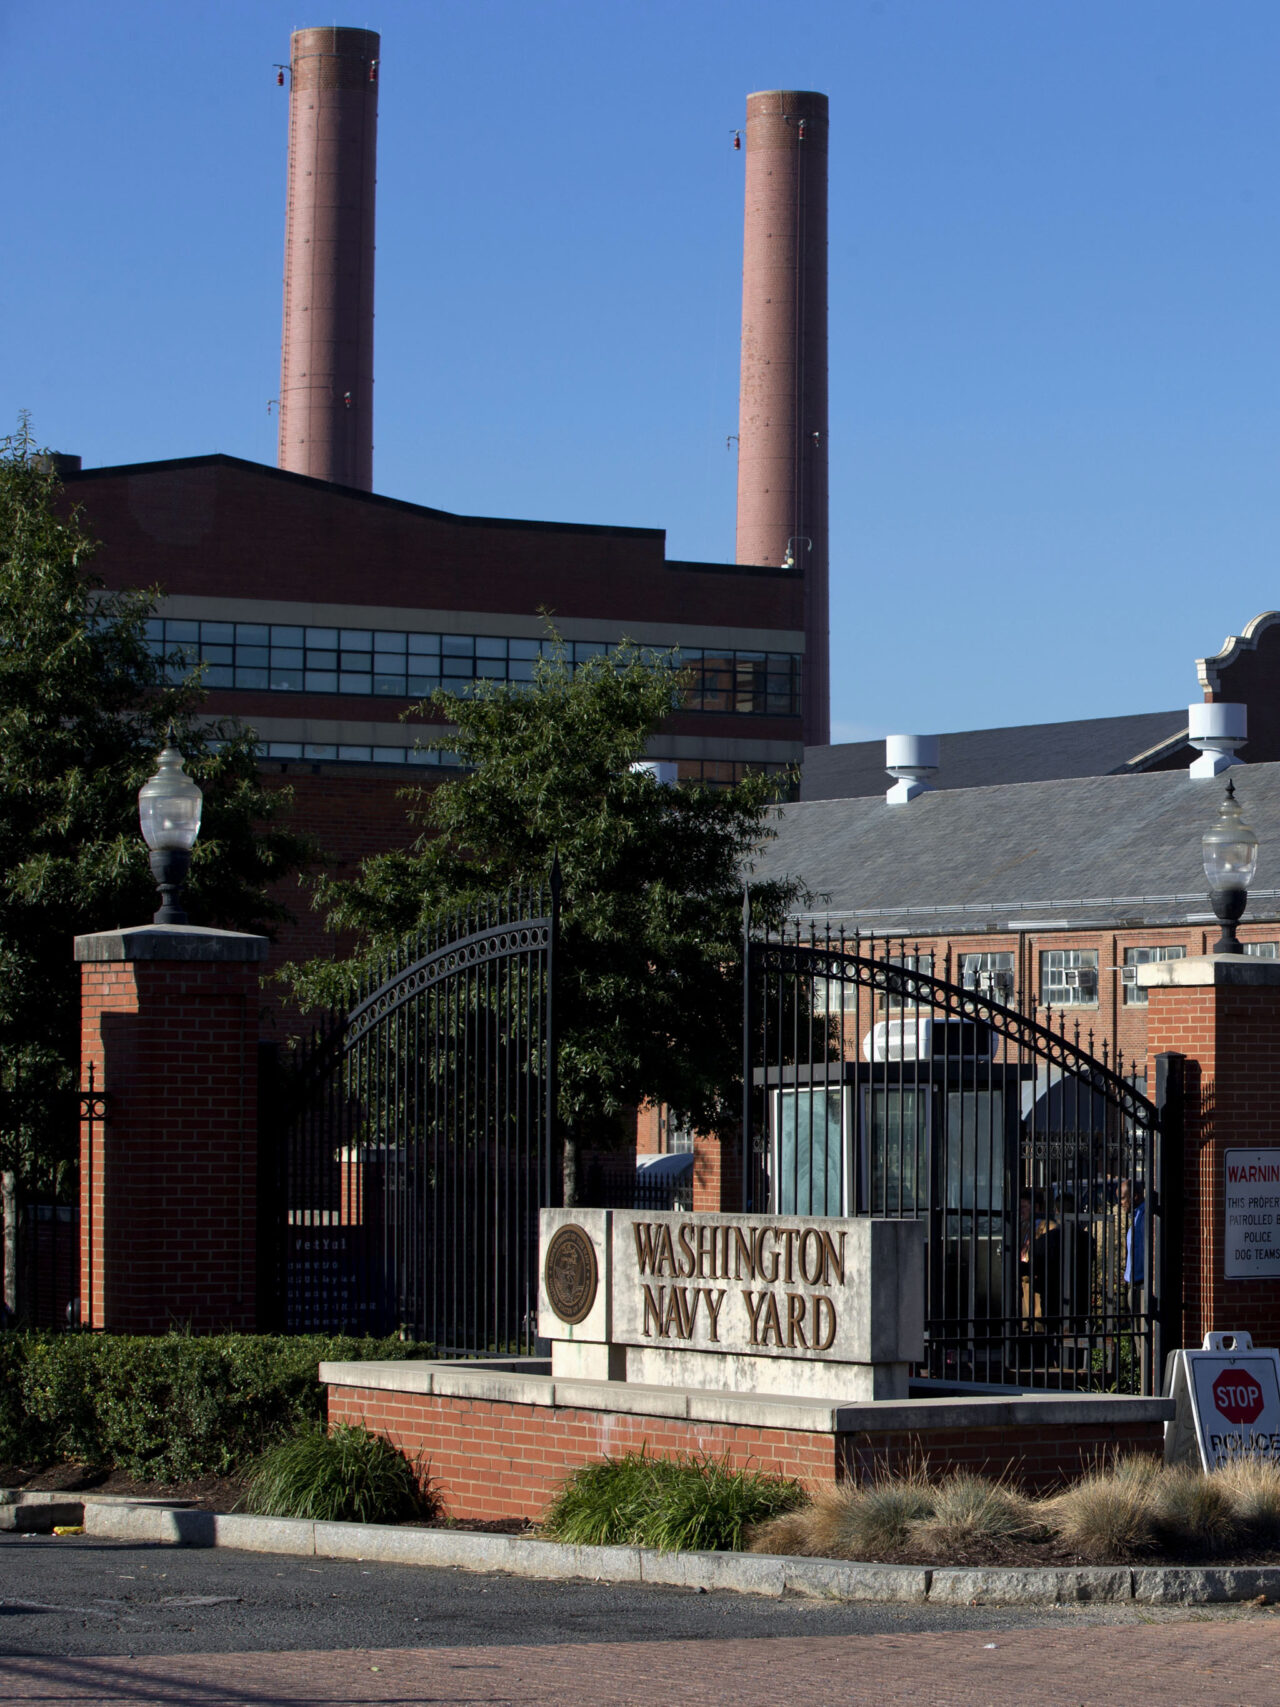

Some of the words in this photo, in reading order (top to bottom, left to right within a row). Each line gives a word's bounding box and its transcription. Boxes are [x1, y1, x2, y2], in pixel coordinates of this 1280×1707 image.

[1228, 1197, 1245, 1209] THIS
[1229, 1214, 1273, 1226] PATROLLED
[1244, 1231, 1272, 1243] POLICE
[632, 1221, 849, 1287] WASHINGTON
[1235, 1249, 1252, 1260] DOG
[1255, 1248, 1280, 1260] TEAMS
[640, 1283, 728, 1343] NAVY
[741, 1289, 837, 1351] YARD
[1216, 1385, 1259, 1408] STOP
